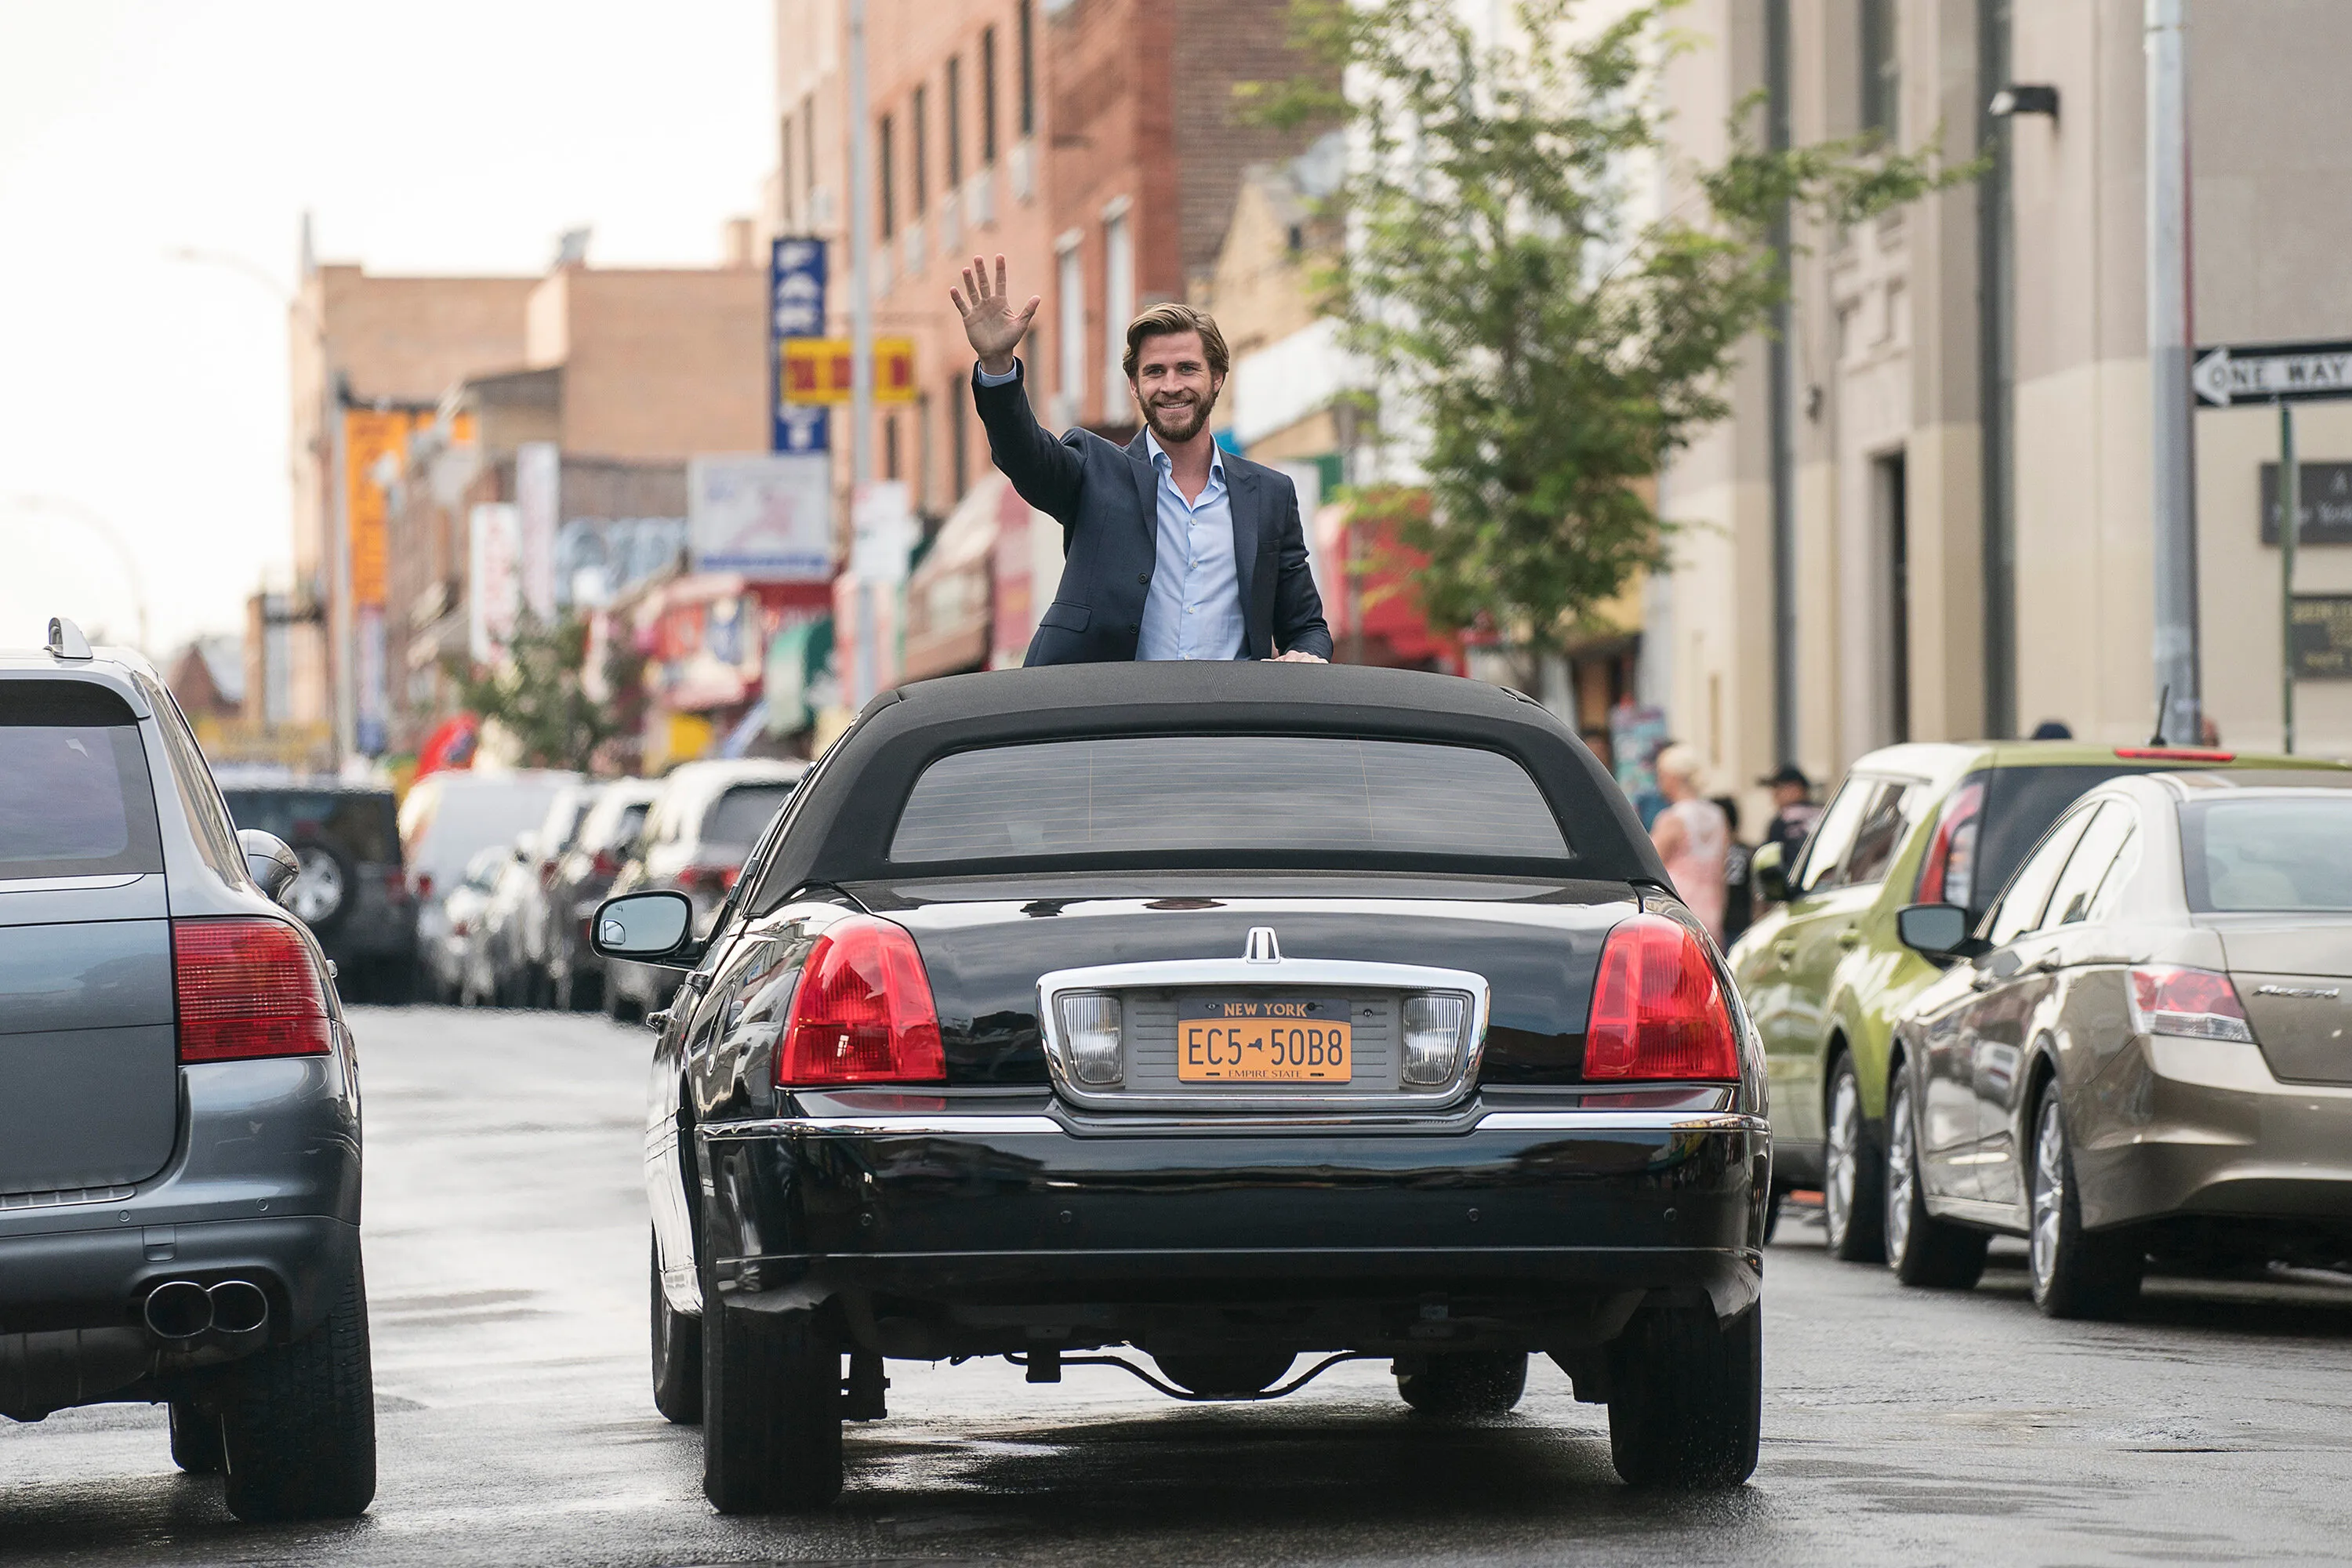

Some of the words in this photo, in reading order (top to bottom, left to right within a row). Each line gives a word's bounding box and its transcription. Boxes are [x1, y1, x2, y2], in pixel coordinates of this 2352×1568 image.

[2209, 360, 2267, 389] ONE
[2288, 355, 2347, 387] WAY
[1223, 1003, 1258, 1018] NEW
[1264, 1003, 1308, 1018] YORK
[1188, 1028, 1243, 1066] EC5
[1270, 1028, 1344, 1066] 50B8
[1228, 1069, 1269, 1079] EMPIRE
[1271, 1069, 1302, 1079] STATE
